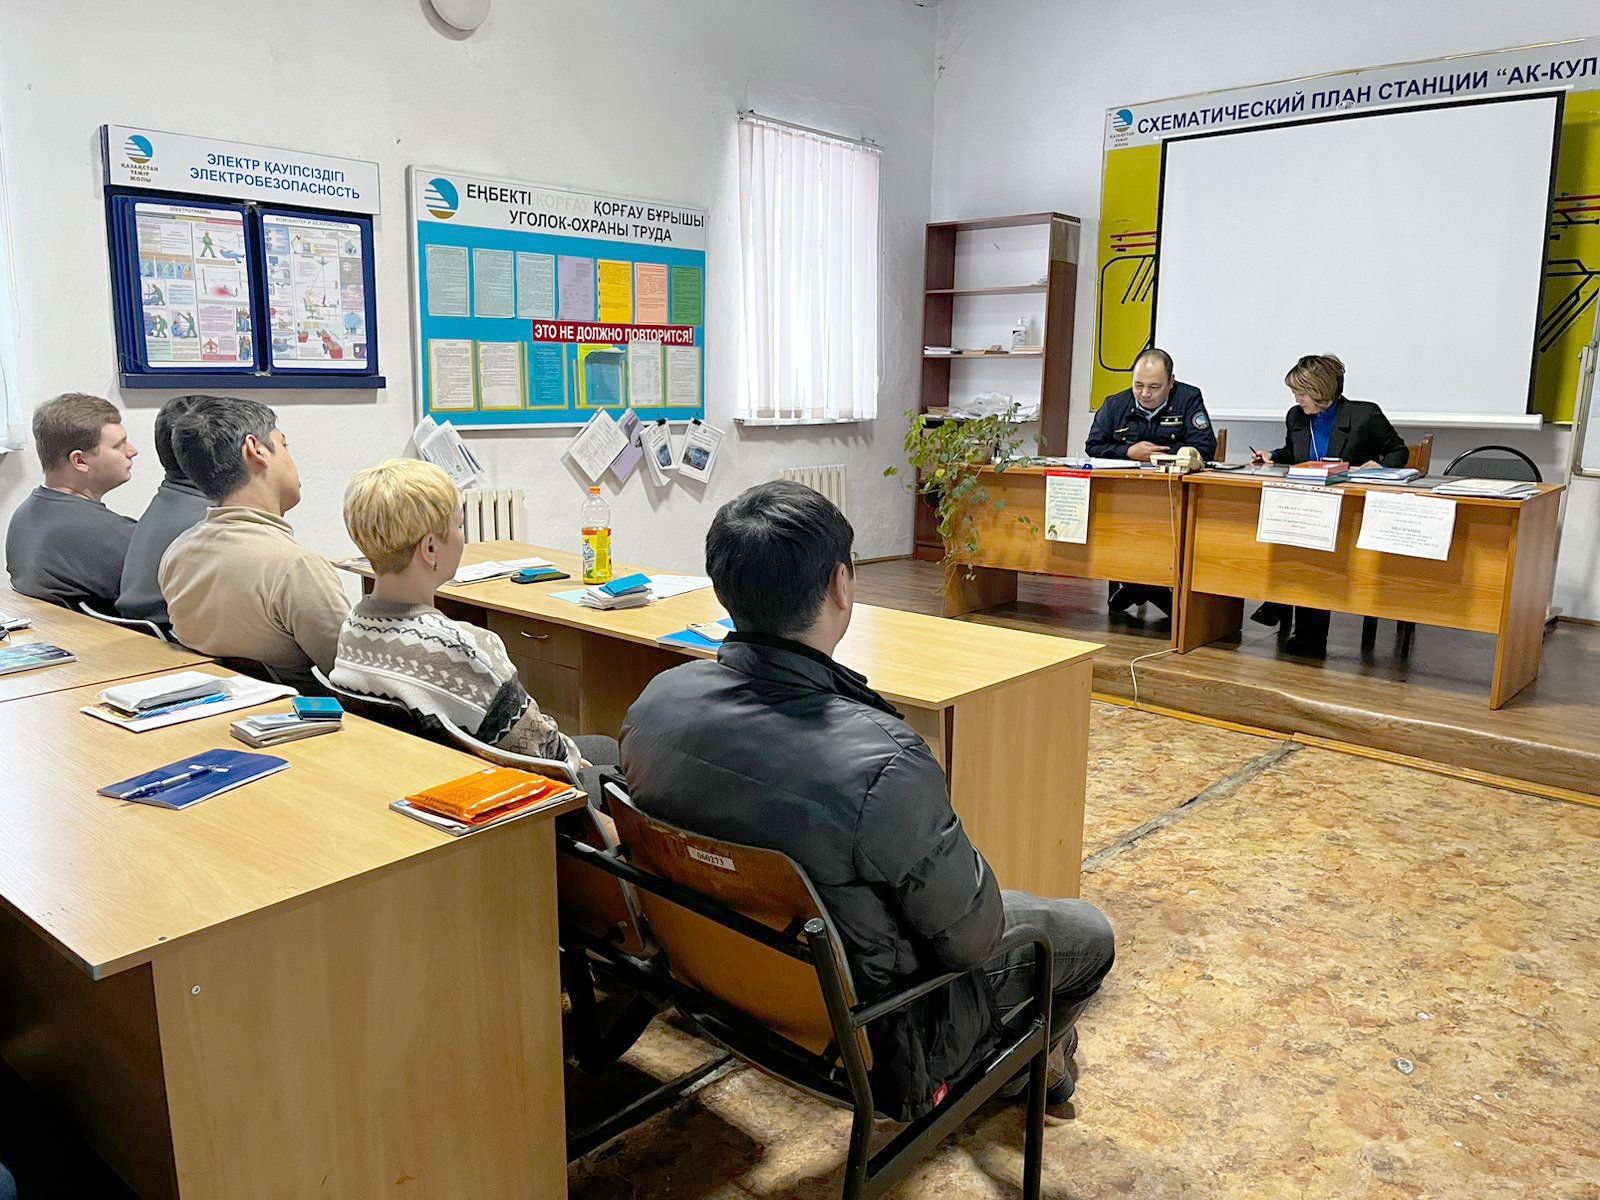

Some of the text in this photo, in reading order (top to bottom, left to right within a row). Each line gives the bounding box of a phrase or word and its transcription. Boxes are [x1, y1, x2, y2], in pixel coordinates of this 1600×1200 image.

[1137, 57, 1600, 134] СХЕМАТИЧЕСКИЙ ПЛАН СТАНЦИИ “АК-КУЛ
[190, 167, 360, 199] ЭЛЕКТРОБЕЗОПАСНОСТЬ
[207, 153, 345, 183] ЭЛЕКТР ҚАУІПСІЗДІГІ
[466, 183, 531, 206] ЕҢБЕКТІ
[593, 200, 644, 220] ҚОРҒАУ
[647, 208, 704, 228] БҰРЫШЫ
[509, 209, 672, 243] УГОЛОК-ОХРАНЫ ТРУДА
[534, 324, 693, 343] ЭТО НЕ ДОЛЖНО ПОВТОРИТСЯ!
